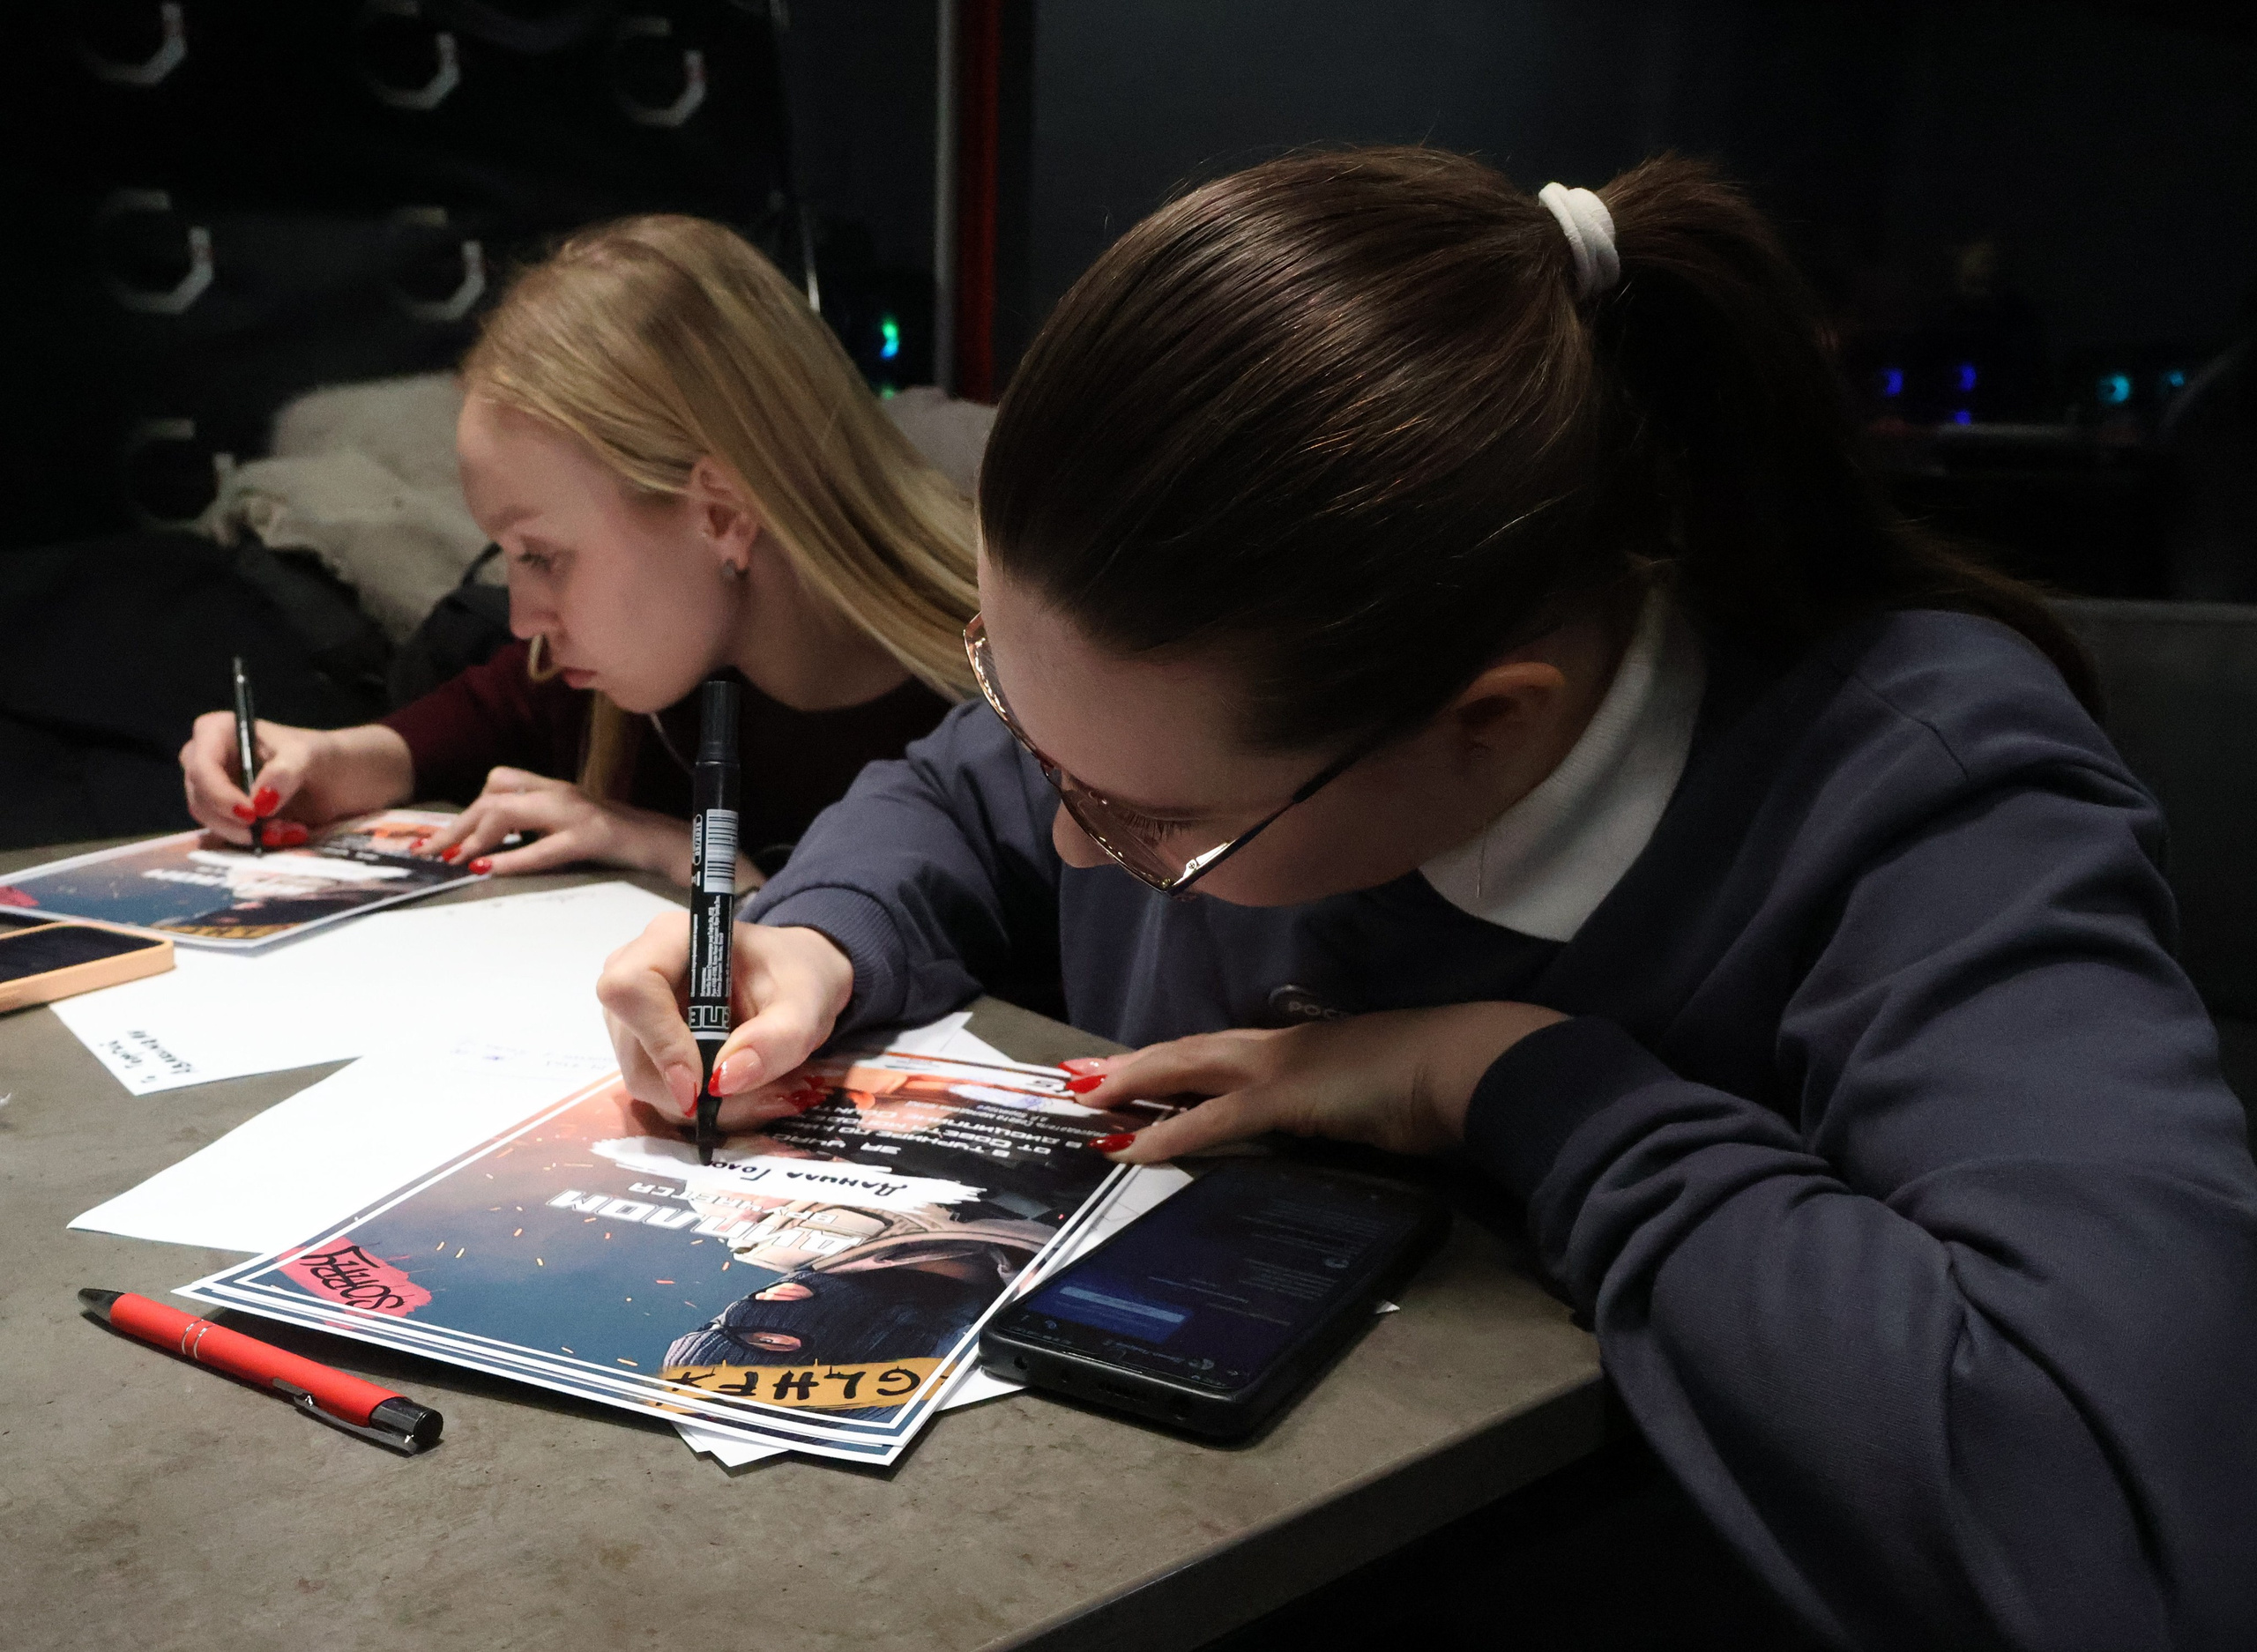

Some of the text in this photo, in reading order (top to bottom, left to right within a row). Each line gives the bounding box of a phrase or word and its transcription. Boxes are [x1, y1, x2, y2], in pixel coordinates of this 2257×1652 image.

[860, 1142, 902, 1155] ЗА
[543, 1187, 865, 1257] ДИПЛОМ
[627, 1181, 838, 1226] ВРУЧАЕТСЯ
[296, 1244, 405, 1311] SORRY
